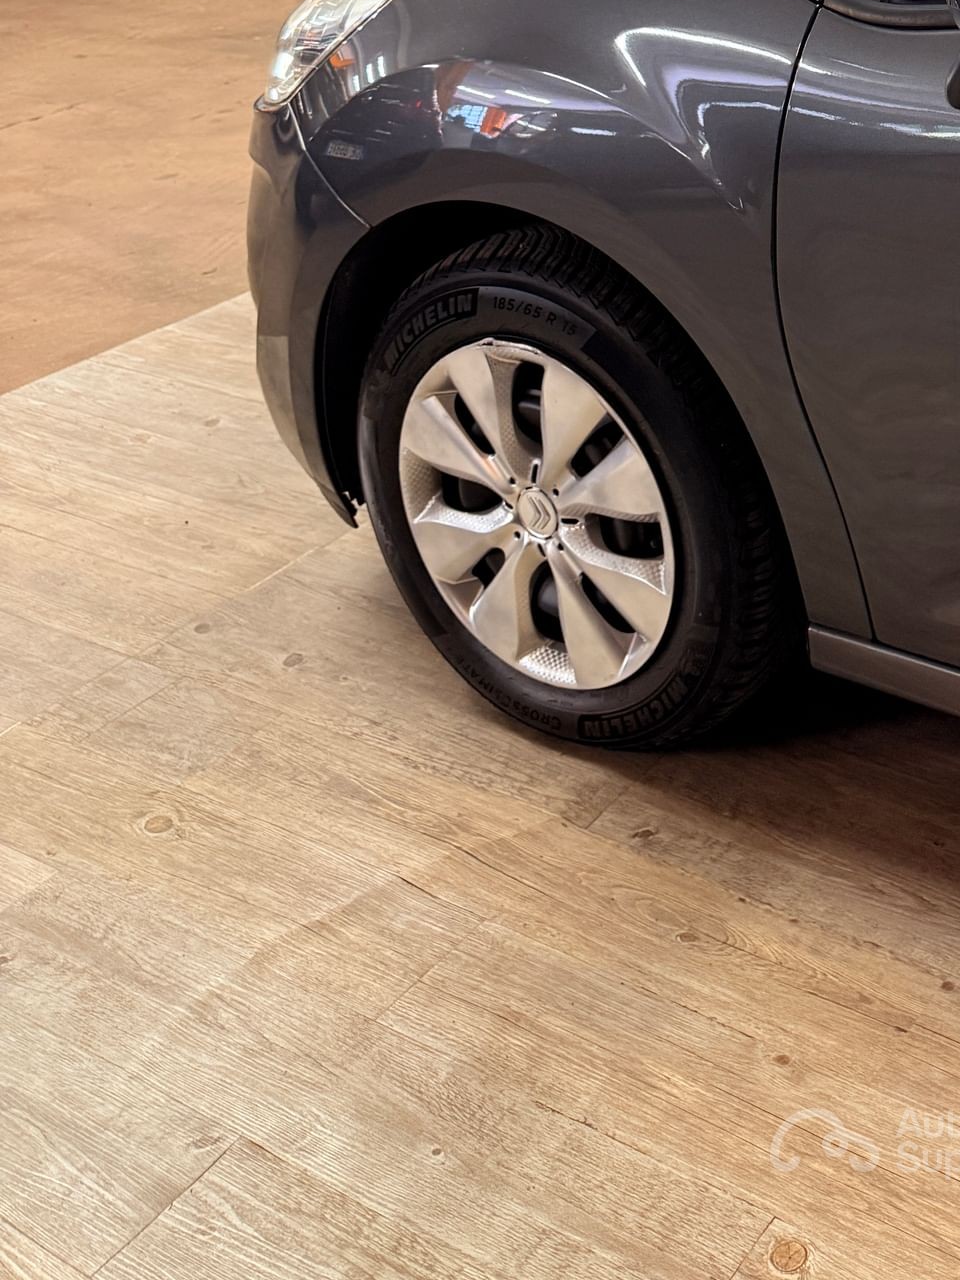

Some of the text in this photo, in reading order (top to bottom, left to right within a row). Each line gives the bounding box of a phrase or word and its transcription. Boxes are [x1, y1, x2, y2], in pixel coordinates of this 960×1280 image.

[382, 293, 473, 367] MICHELIN
[493, 296, 577, 336] 185/65 R 15
[583, 676, 689, 738] MICHELIN
